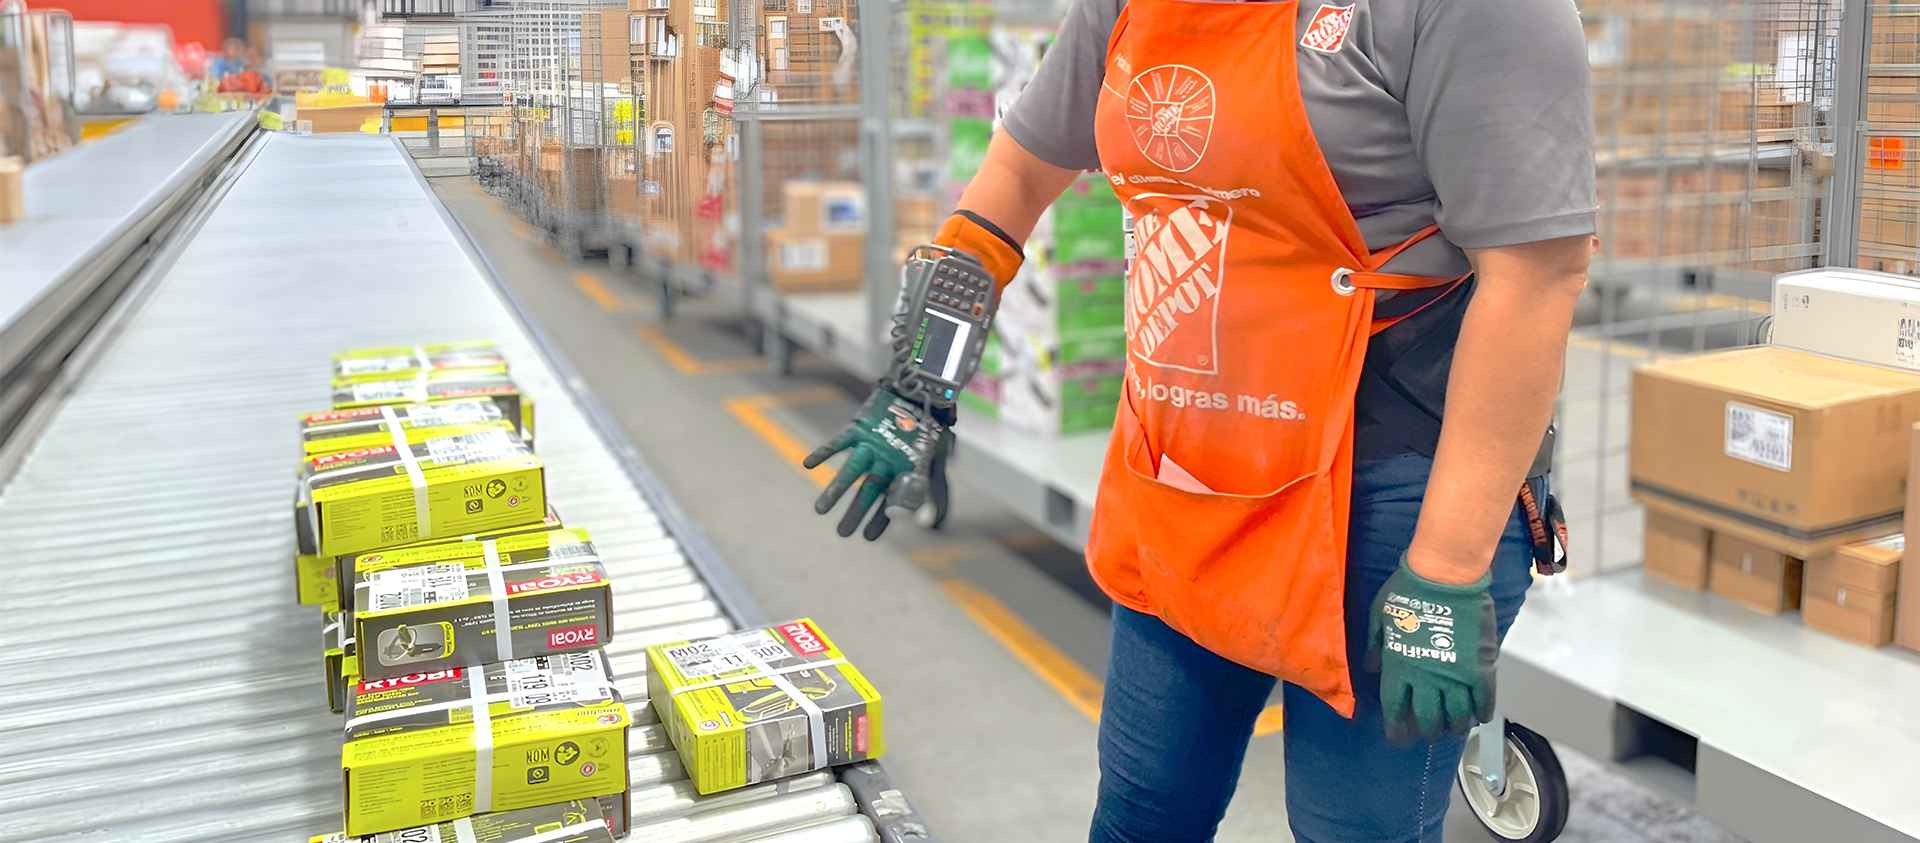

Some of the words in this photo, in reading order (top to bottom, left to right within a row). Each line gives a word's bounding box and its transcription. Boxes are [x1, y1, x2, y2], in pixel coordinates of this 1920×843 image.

[1139, 262, 1217, 359] DEPOT
[1148, 376, 1229, 410] logras
[551, 628, 595, 646] RYOBI
[784, 622, 825, 654] RYOBI
[1385, 639, 1457, 663] MaxiFlex
